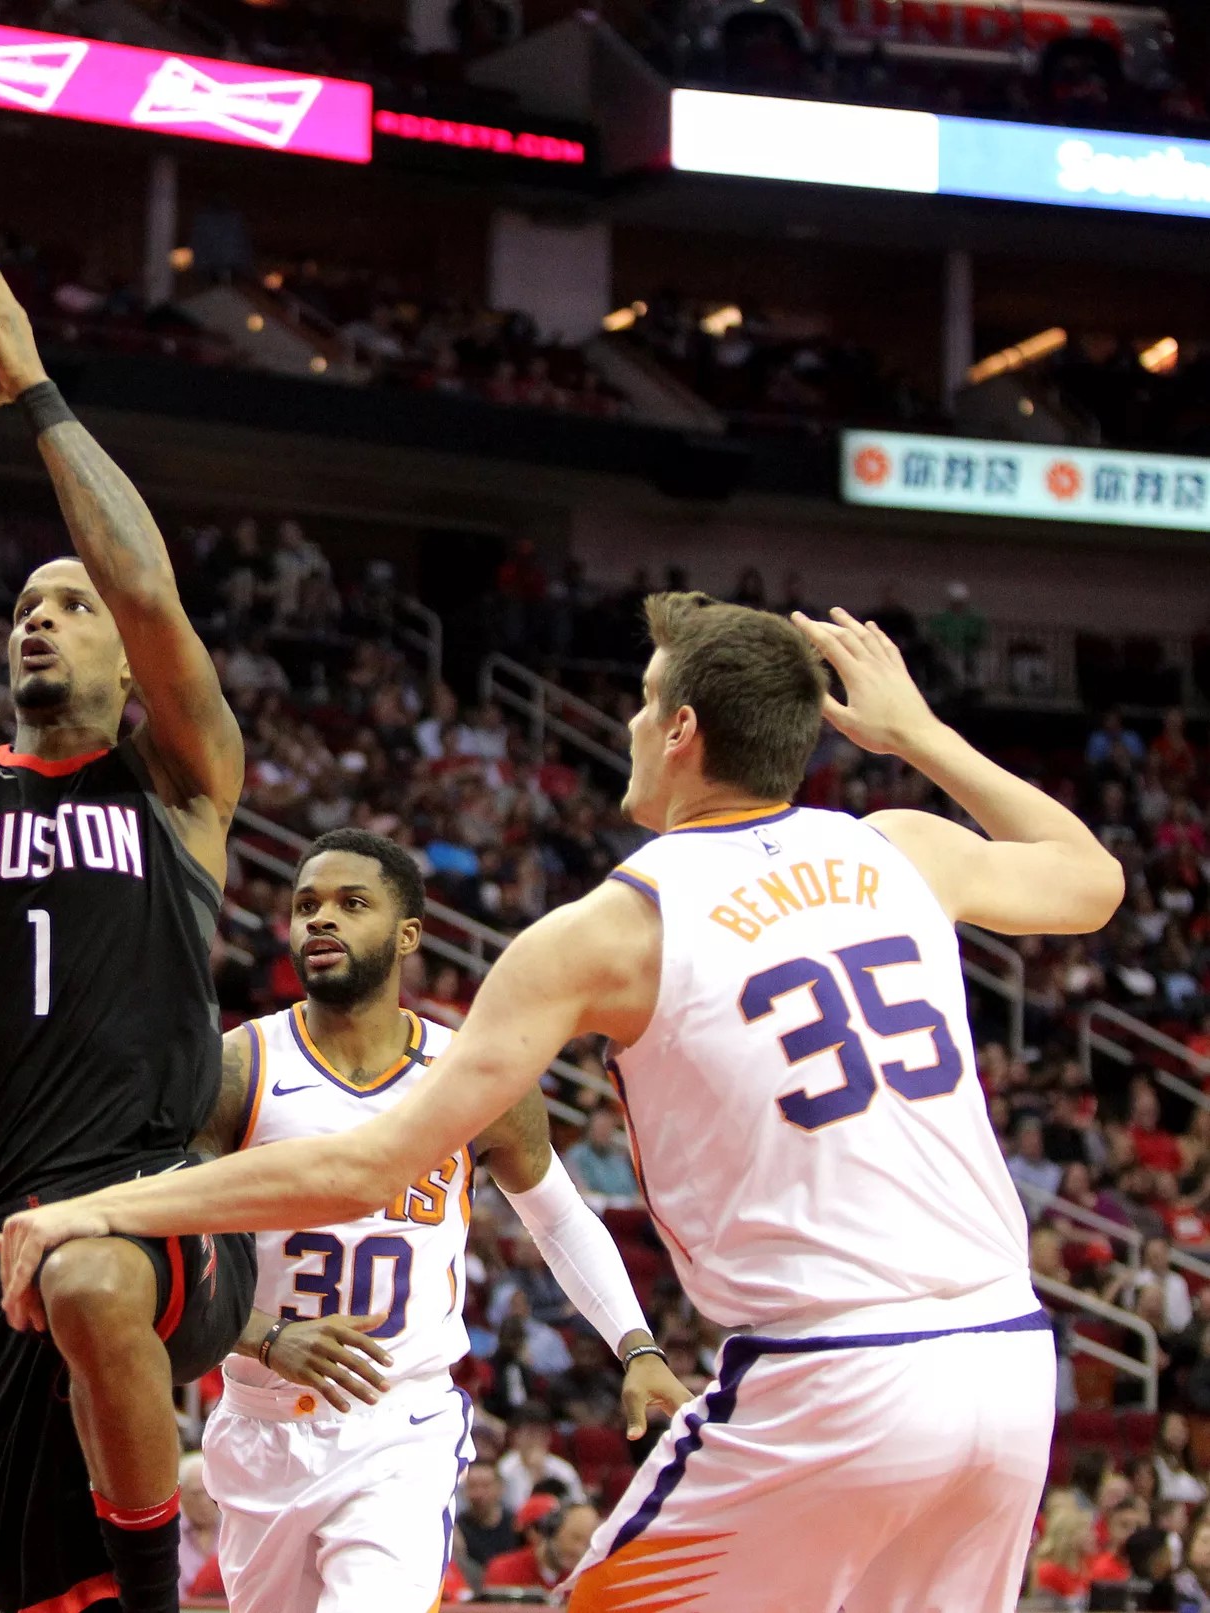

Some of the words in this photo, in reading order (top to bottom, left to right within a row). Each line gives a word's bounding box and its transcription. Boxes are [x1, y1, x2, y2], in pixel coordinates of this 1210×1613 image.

[708, 858, 879, 943] BENDER
[27, 909, 51, 1016] 1
[737, 934, 963, 1133] 35
[279, 1231, 414, 1341] 30
